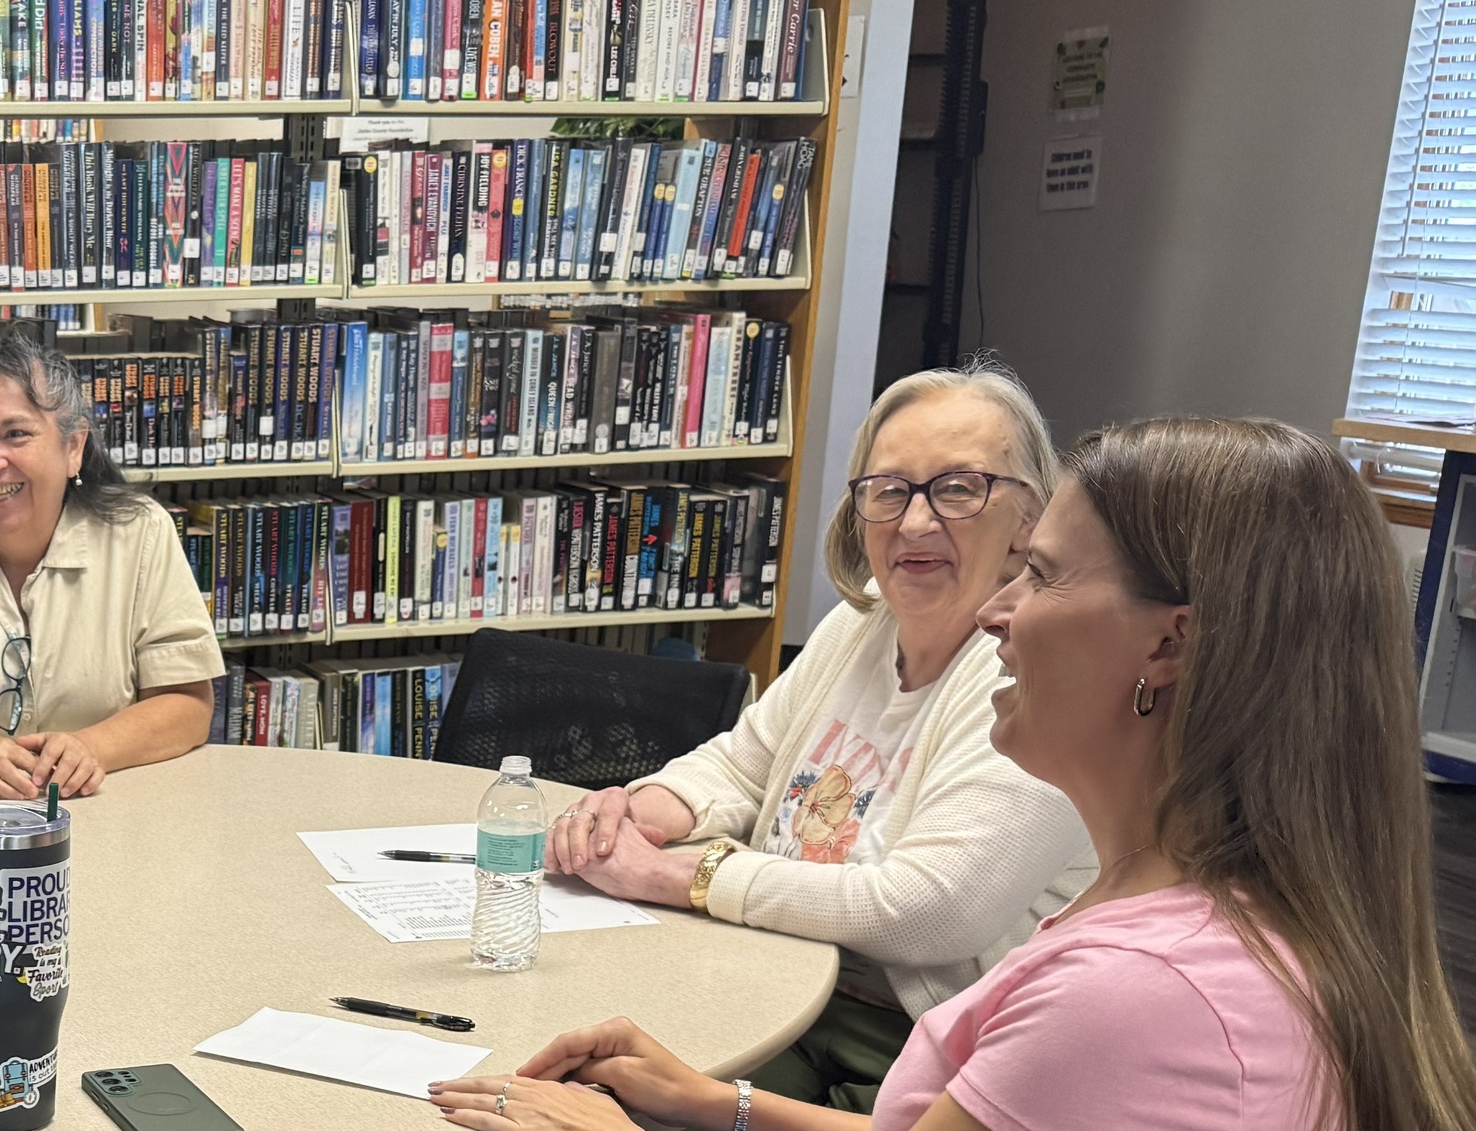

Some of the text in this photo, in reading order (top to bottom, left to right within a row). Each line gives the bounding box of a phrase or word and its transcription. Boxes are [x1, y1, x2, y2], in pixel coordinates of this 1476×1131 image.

[137, 24, 145, 51] SPIN
[292, 6, 301, 34] LIFE
[489, 21, 501, 57] COBEN
[787, 13, 800, 53] Carrie
[105, 149, 114, 181] Midnight
[478, 155, 489, 207] JOY FIELDING
[517, 144, 526, 166] DICK
[548, 145, 561, 217] LISA GARDNER
[797, 141, 809, 169] HOAG
[805, 147, 815, 168] TAMI
[83, 149, 95, 234] This Book Will Bury
[426, 169, 439, 232] JANET EVANOVICH
[695, 157, 712, 217] SUE GRAFTON
[265, 331, 275, 404] STUART WOODS
[280, 332, 291, 402] STUART WOODS
[297, 332, 308, 402] STUART WOODS
[308, 329, 321, 403] STUART WOODS
[219, 512, 228, 578] STUART WOODS
[254, 511, 264, 576] STUART WOODS
[320, 505, 328, 540] STUART
[591, 493, 604, 570] JAMES PATTERSON
[604, 514, 618, 584] JAMES PATTERSON
[689, 512, 704, 578] JAMES PATTERSON
[709, 514, 721, 577] JAMES PATTERSON
[414, 678, 422, 719] LOUISE
[28, 968, 63, 983] Favorite
[33, 981, 58, 998] Sport
